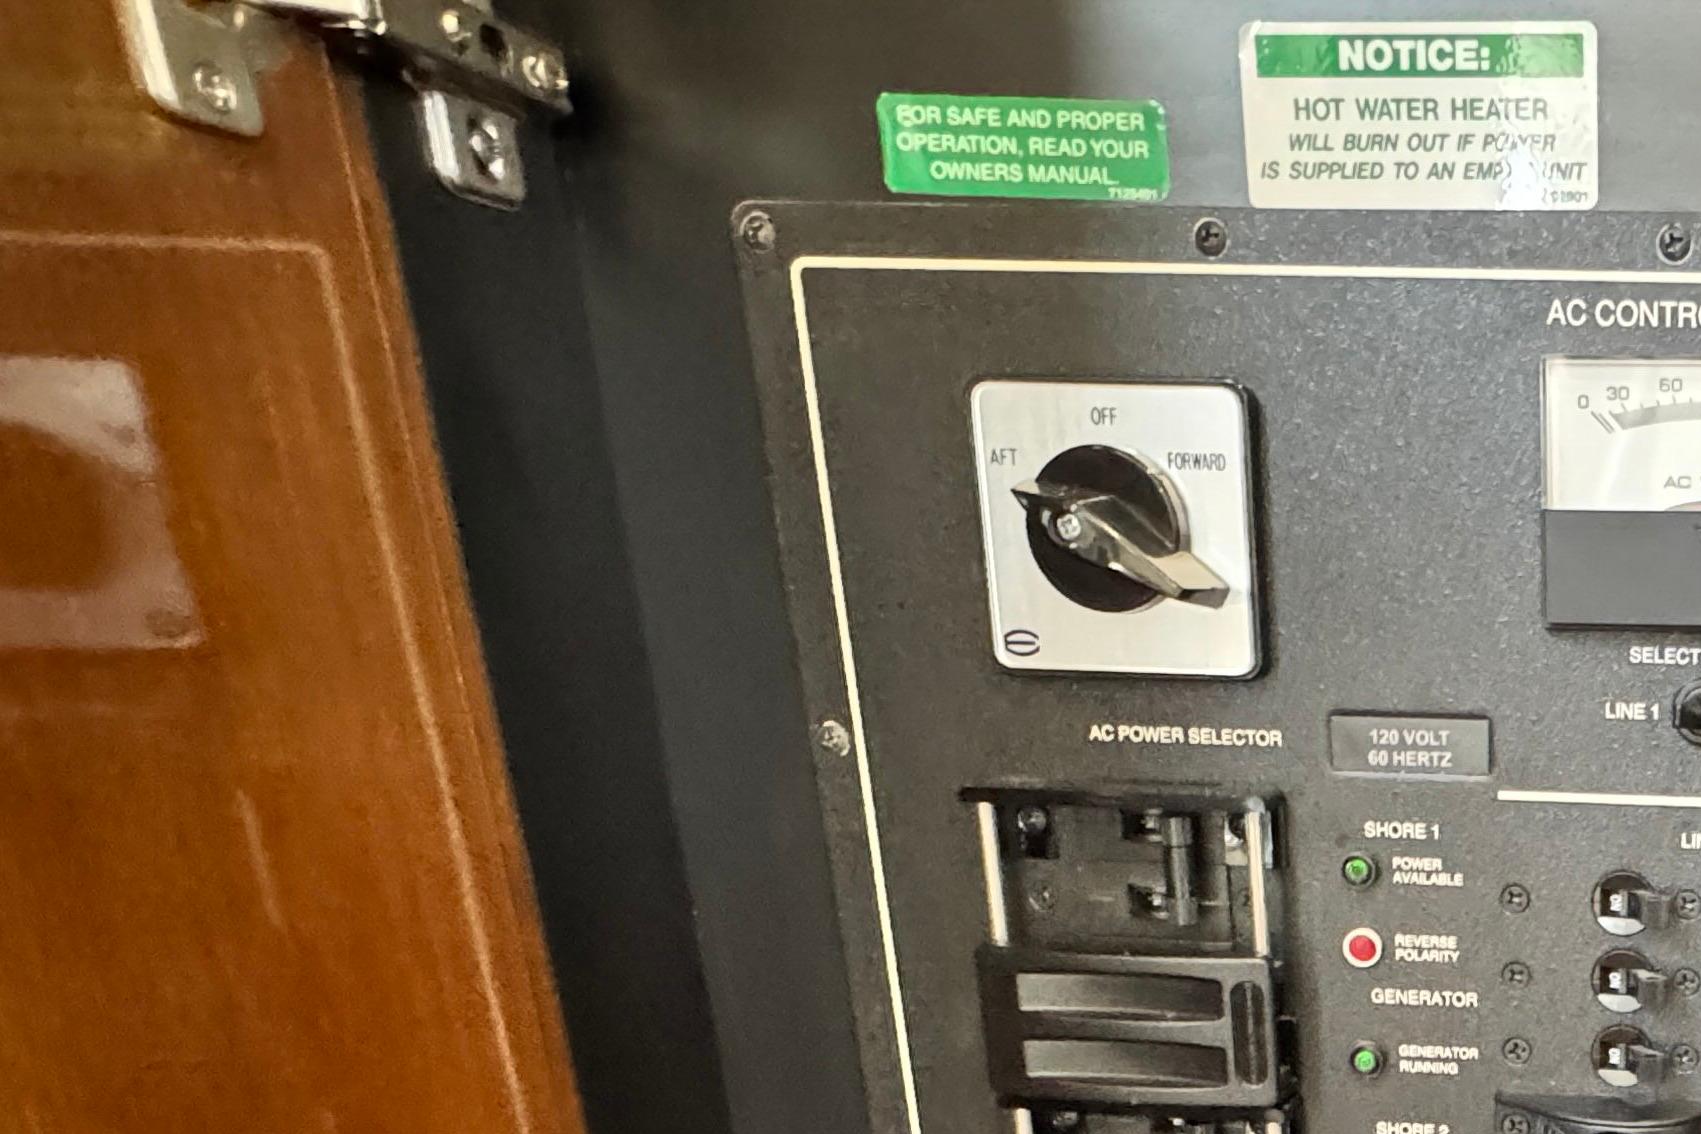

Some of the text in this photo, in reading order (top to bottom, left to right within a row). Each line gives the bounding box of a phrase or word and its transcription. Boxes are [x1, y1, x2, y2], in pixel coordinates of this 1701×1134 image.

[1338, 39, 1491, 72] NOTICE:
[896, 105, 1145, 132] FOR SAFE AND PROPER
[1293, 98, 1549, 121] HOT WATER HEATER
[896, 132, 1149, 158] OPERATION, READ YOUR
[1289, 134, 1477, 151] WILL BURN OUT IF
[930, 161, 1120, 185] OWNERS MANUAL.
[1261, 162, 1456, 180] IS SUPPLIED TO AN
[1546, 299, 1586, 327] AC
[1577, 395, 1589, 409] 0
[1606, 386, 1630, 401] 30
[1659, 378, 1683, 393] 60
[1090, 407, 1117, 425] OFF
[990, 448, 1017, 466] AFT
[1168, 453, 1226, 472] FORWARD
[1663, 476, 1692, 489] AC
[1629, 646, 1701, 666] SELECT
[1605, 702, 1660, 721] LINE 1
[1088, 725, 1283, 748] AC POWER SELECTOR
[1368, 729, 1450, 747] 120 VOLT
[1368, 751, 1453, 768] 60 HERTZ
[1364, 820, 1440, 840] SHORE 1
[1392, 856, 1443, 871] POWER
[1392, 872, 1464, 887] AVAILABLE
[1394, 934, 1458, 949] REVERSE
[1395, 949, 1460, 963] POLARITY
[1370, 988, 1478, 1008] GENERATOR
[1398, 1044, 1479, 1060] GENERATOR
[1399, 1060, 1459, 1075] RUNNING
